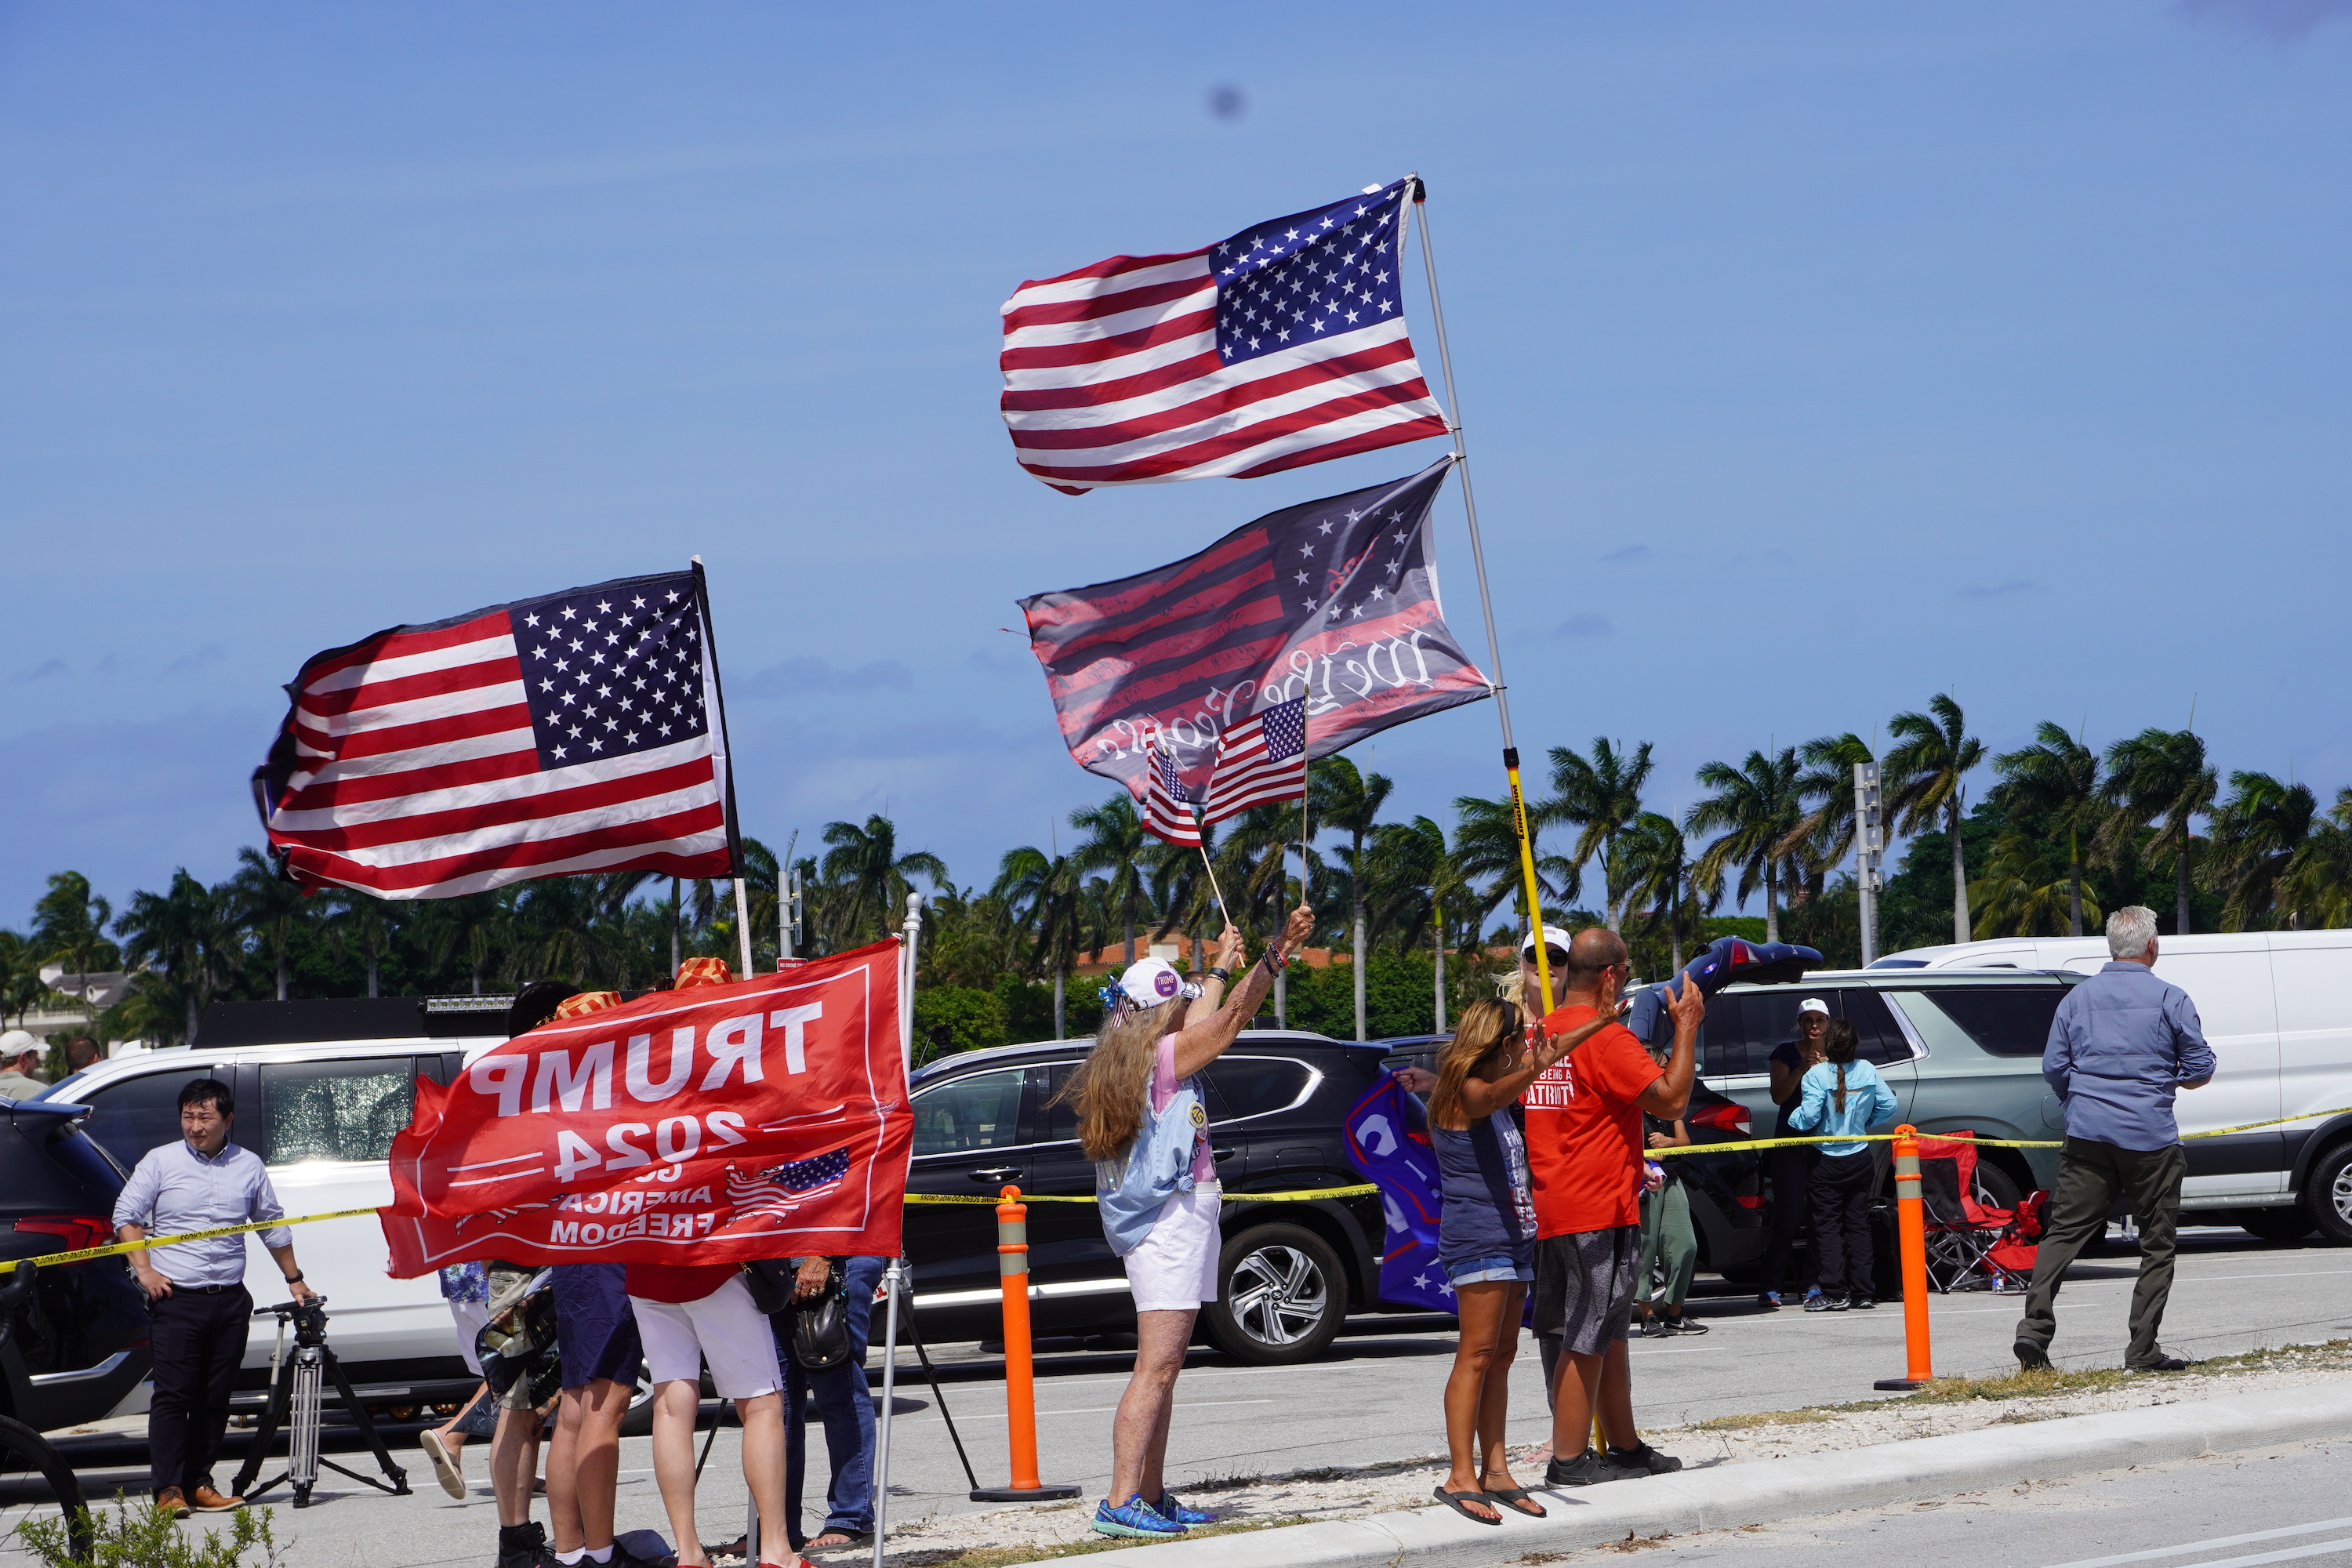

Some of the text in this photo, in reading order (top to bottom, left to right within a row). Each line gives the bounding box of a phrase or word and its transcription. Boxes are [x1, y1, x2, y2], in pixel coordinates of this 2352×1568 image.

[1156, 975, 1174, 985] TRUMP
[1539, 1069, 1573, 1080] BEING A
[1526, 1084, 1569, 1105] ATRIOT
[1192, 1108, 1204, 1123] 45
[93, 1246, 114, 1256] CRIME
[38, 1255, 56, 1265] NOT
